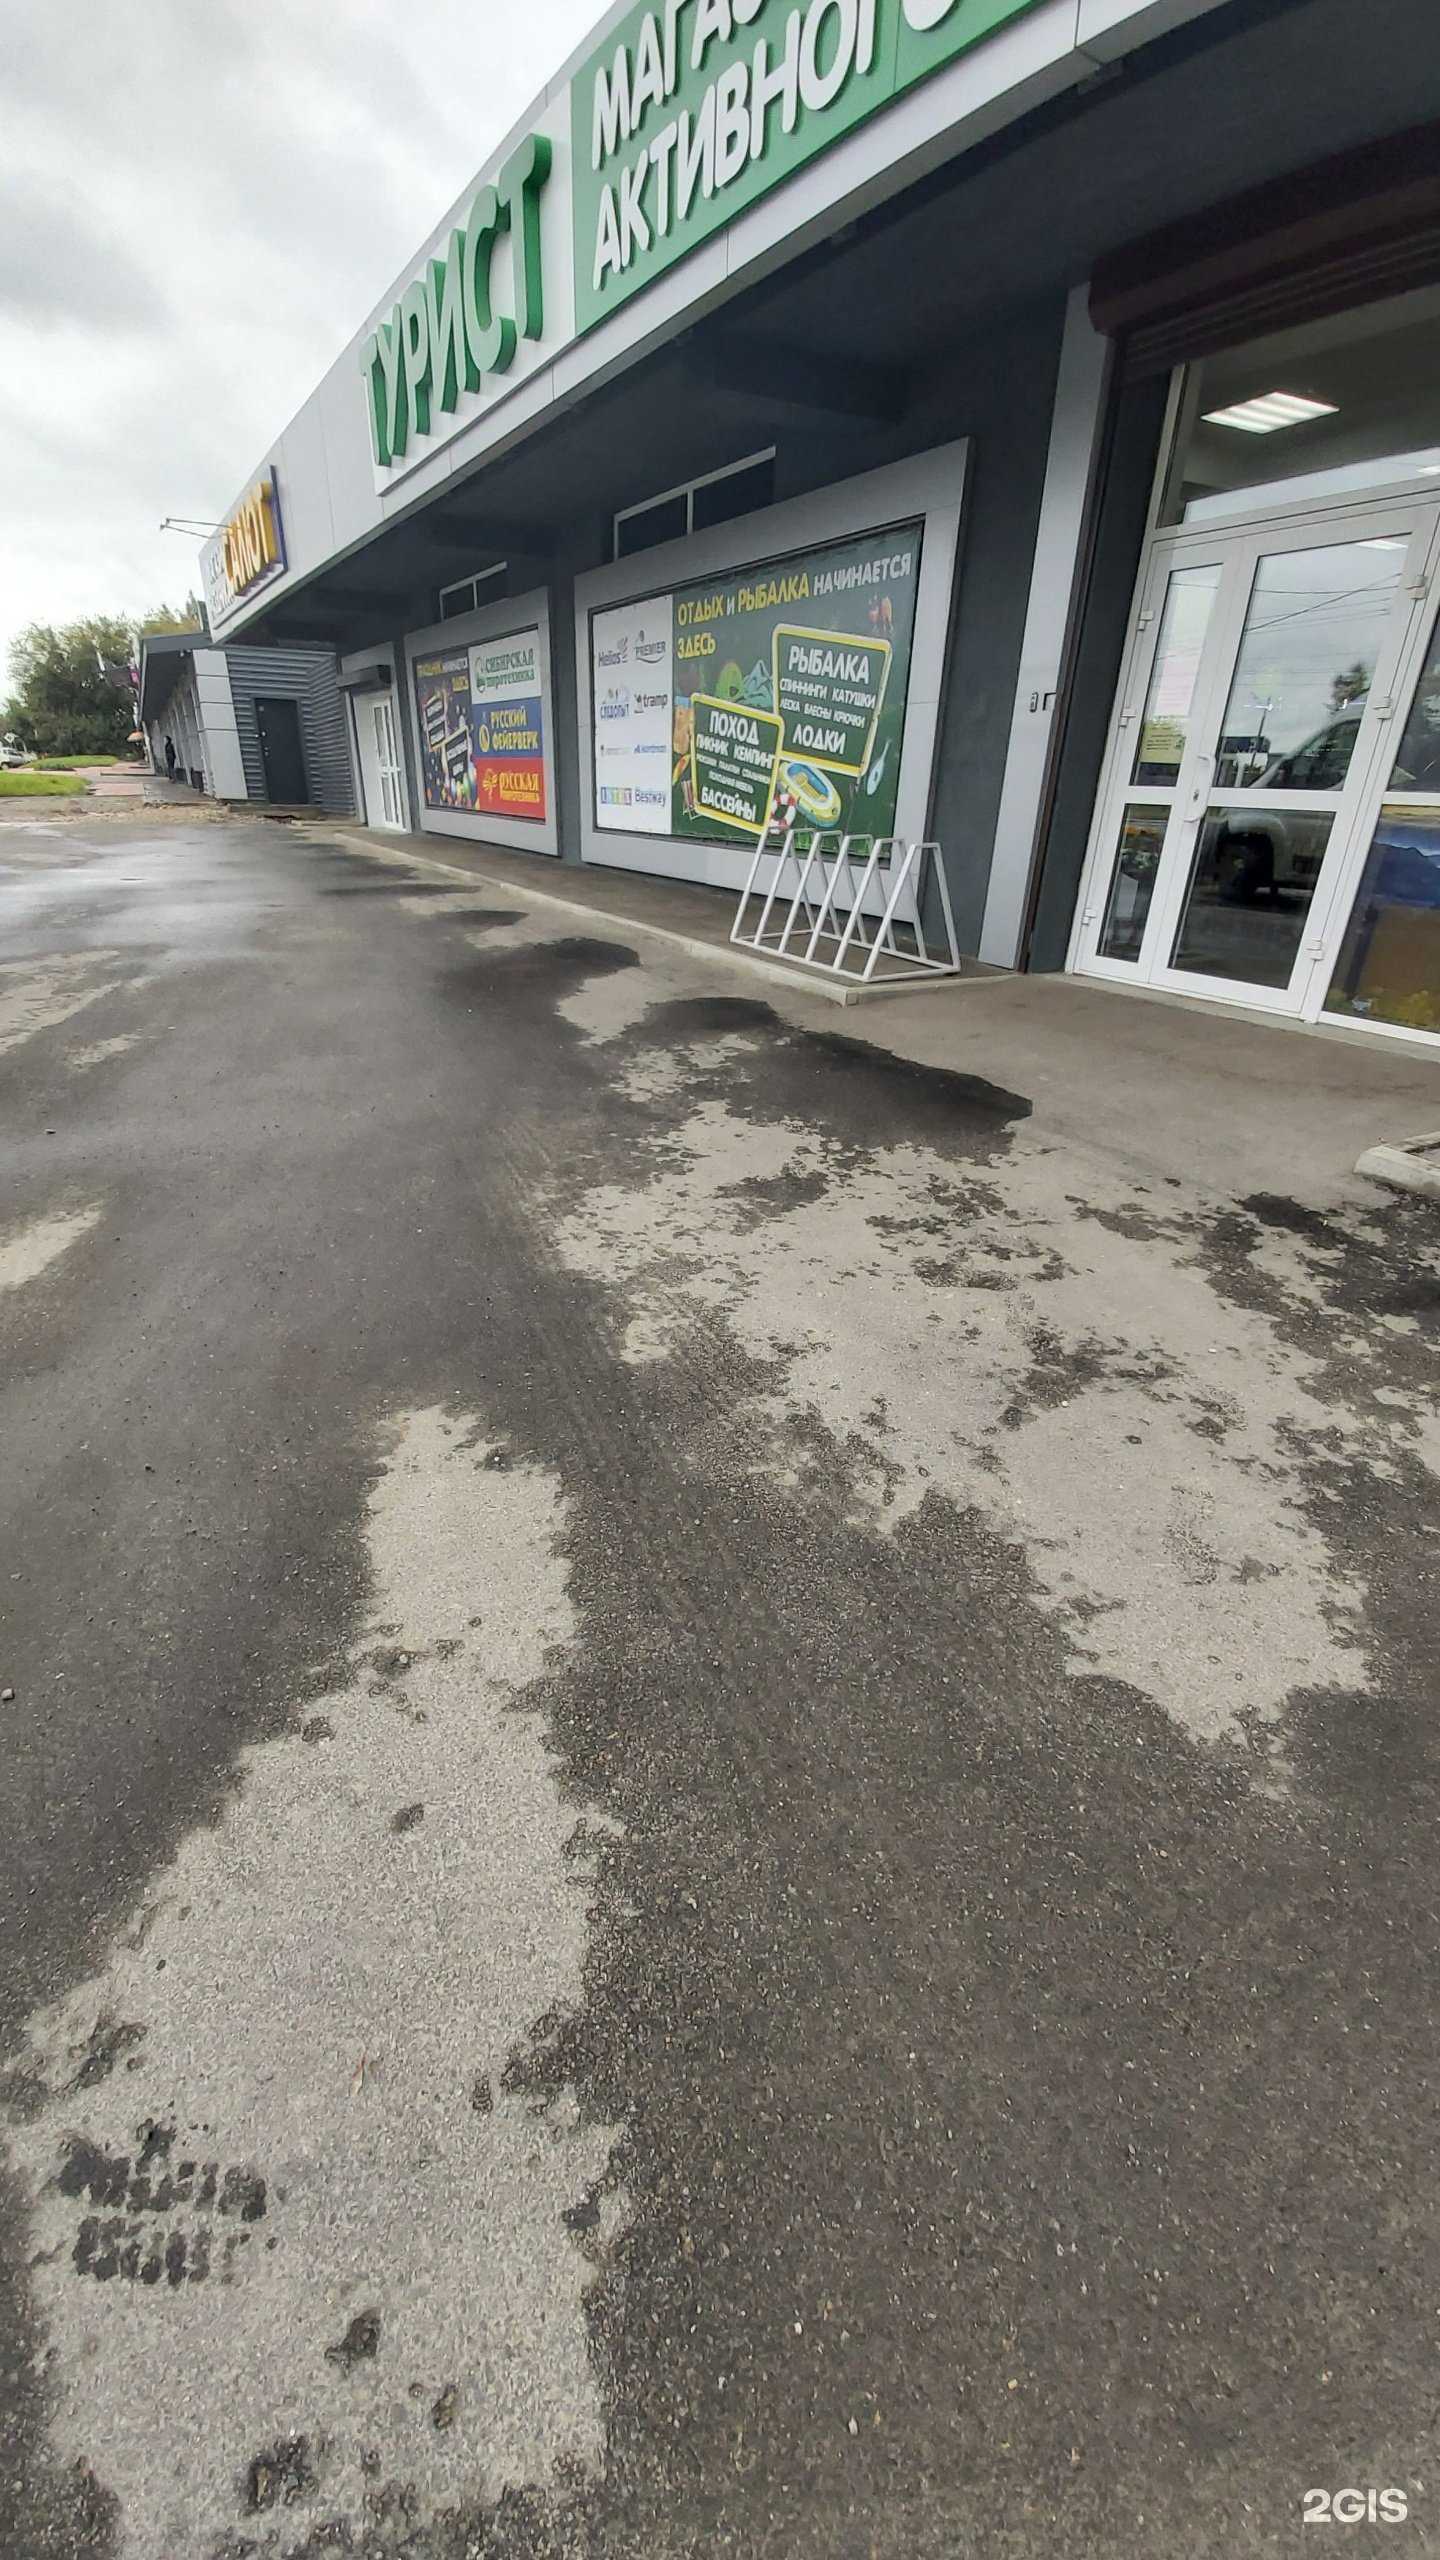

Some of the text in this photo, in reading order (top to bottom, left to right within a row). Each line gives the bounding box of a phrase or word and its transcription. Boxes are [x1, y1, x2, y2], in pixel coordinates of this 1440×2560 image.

[360, 133, 552, 467] ТУРИСТ
[222, 481, 276, 598] САЛЮТ
[677, 594, 724, 626] ОТДЫХ
[738, 573, 810, 612] РЫБАЛКА
[813, 552, 912, 596] НАЧИНАЕТСЯ
[486, 648, 533, 673] СИБИРСКАЯ
[677, 631, 716, 659] ЗДЕСЬ
[788, 645, 870, 684] РЫБАЛКА
[643, 694, 668, 708] tramp
[831, 687, 876, 709] КАТУШКИ
[491, 705, 527, 728] РУССКИЙ
[709, 710, 760, 745] ПОХОД
[696, 733, 729, 756] ПИКНИК
[733, 744, 775, 769] КЕМПИНГ
[792, 723, 846, 755] ЛОДКИ
[701, 786, 757, 822] БАССЕЙНЫ
